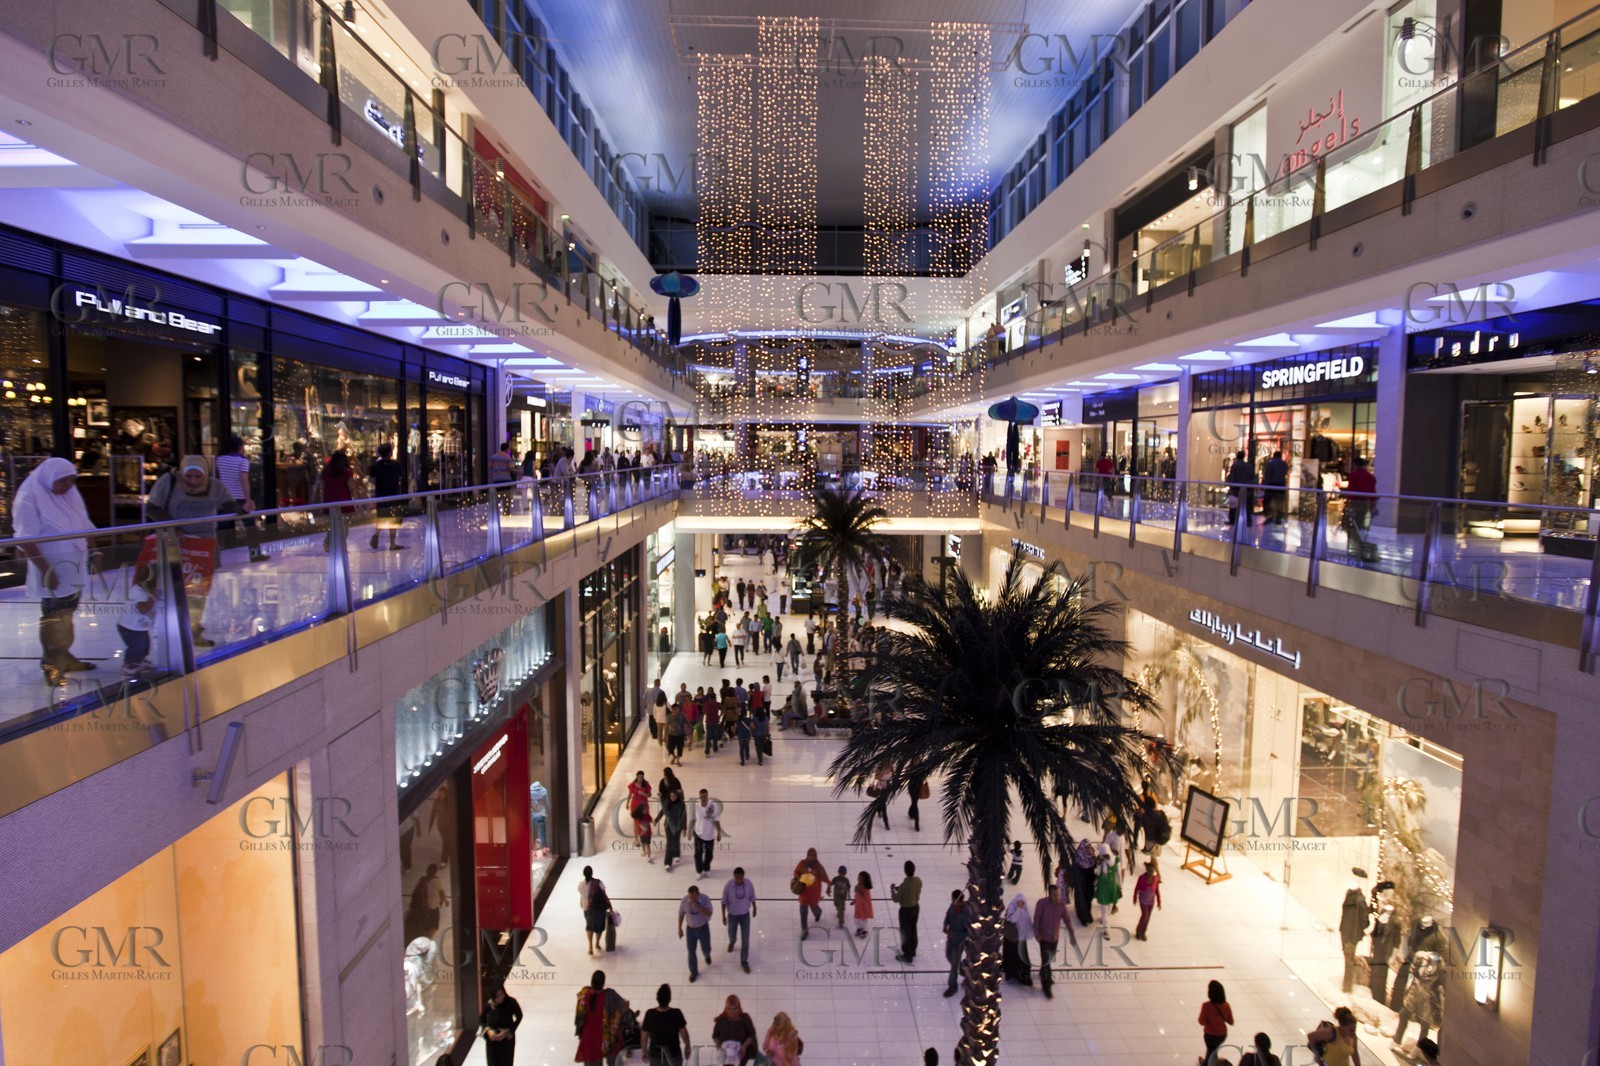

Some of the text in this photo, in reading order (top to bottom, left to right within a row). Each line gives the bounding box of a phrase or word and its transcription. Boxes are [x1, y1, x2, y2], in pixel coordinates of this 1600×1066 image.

[75, 290, 222, 335] Pull and Bear
[1262, 355, 1364, 390] SPRINGFIELD
